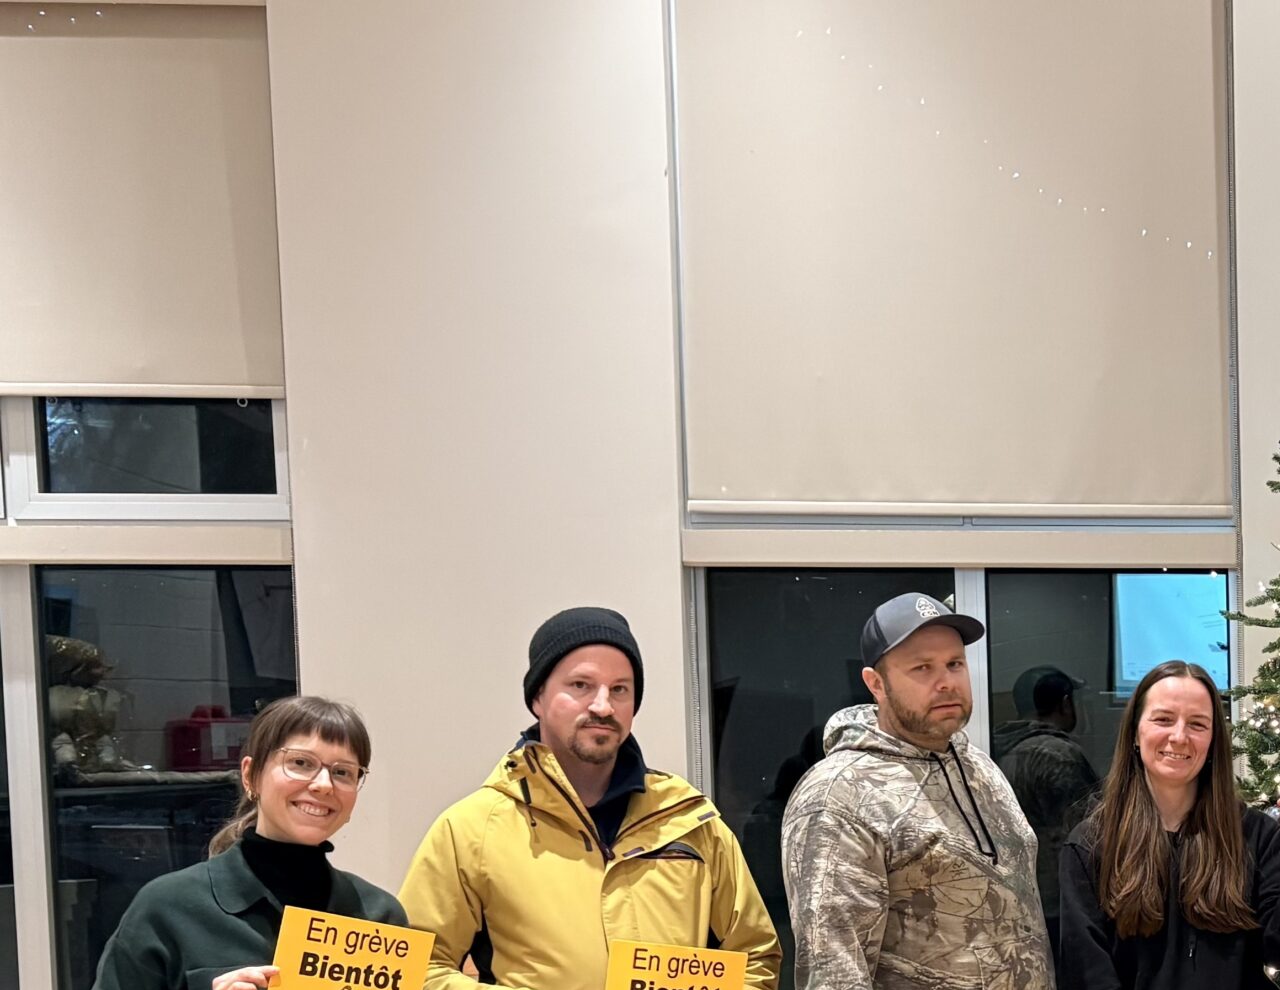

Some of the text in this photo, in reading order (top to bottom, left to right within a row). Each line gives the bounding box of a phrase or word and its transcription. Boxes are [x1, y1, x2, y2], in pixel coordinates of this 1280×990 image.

[306, 917, 409, 958] En grève
[632, 948, 725, 979] En grève
